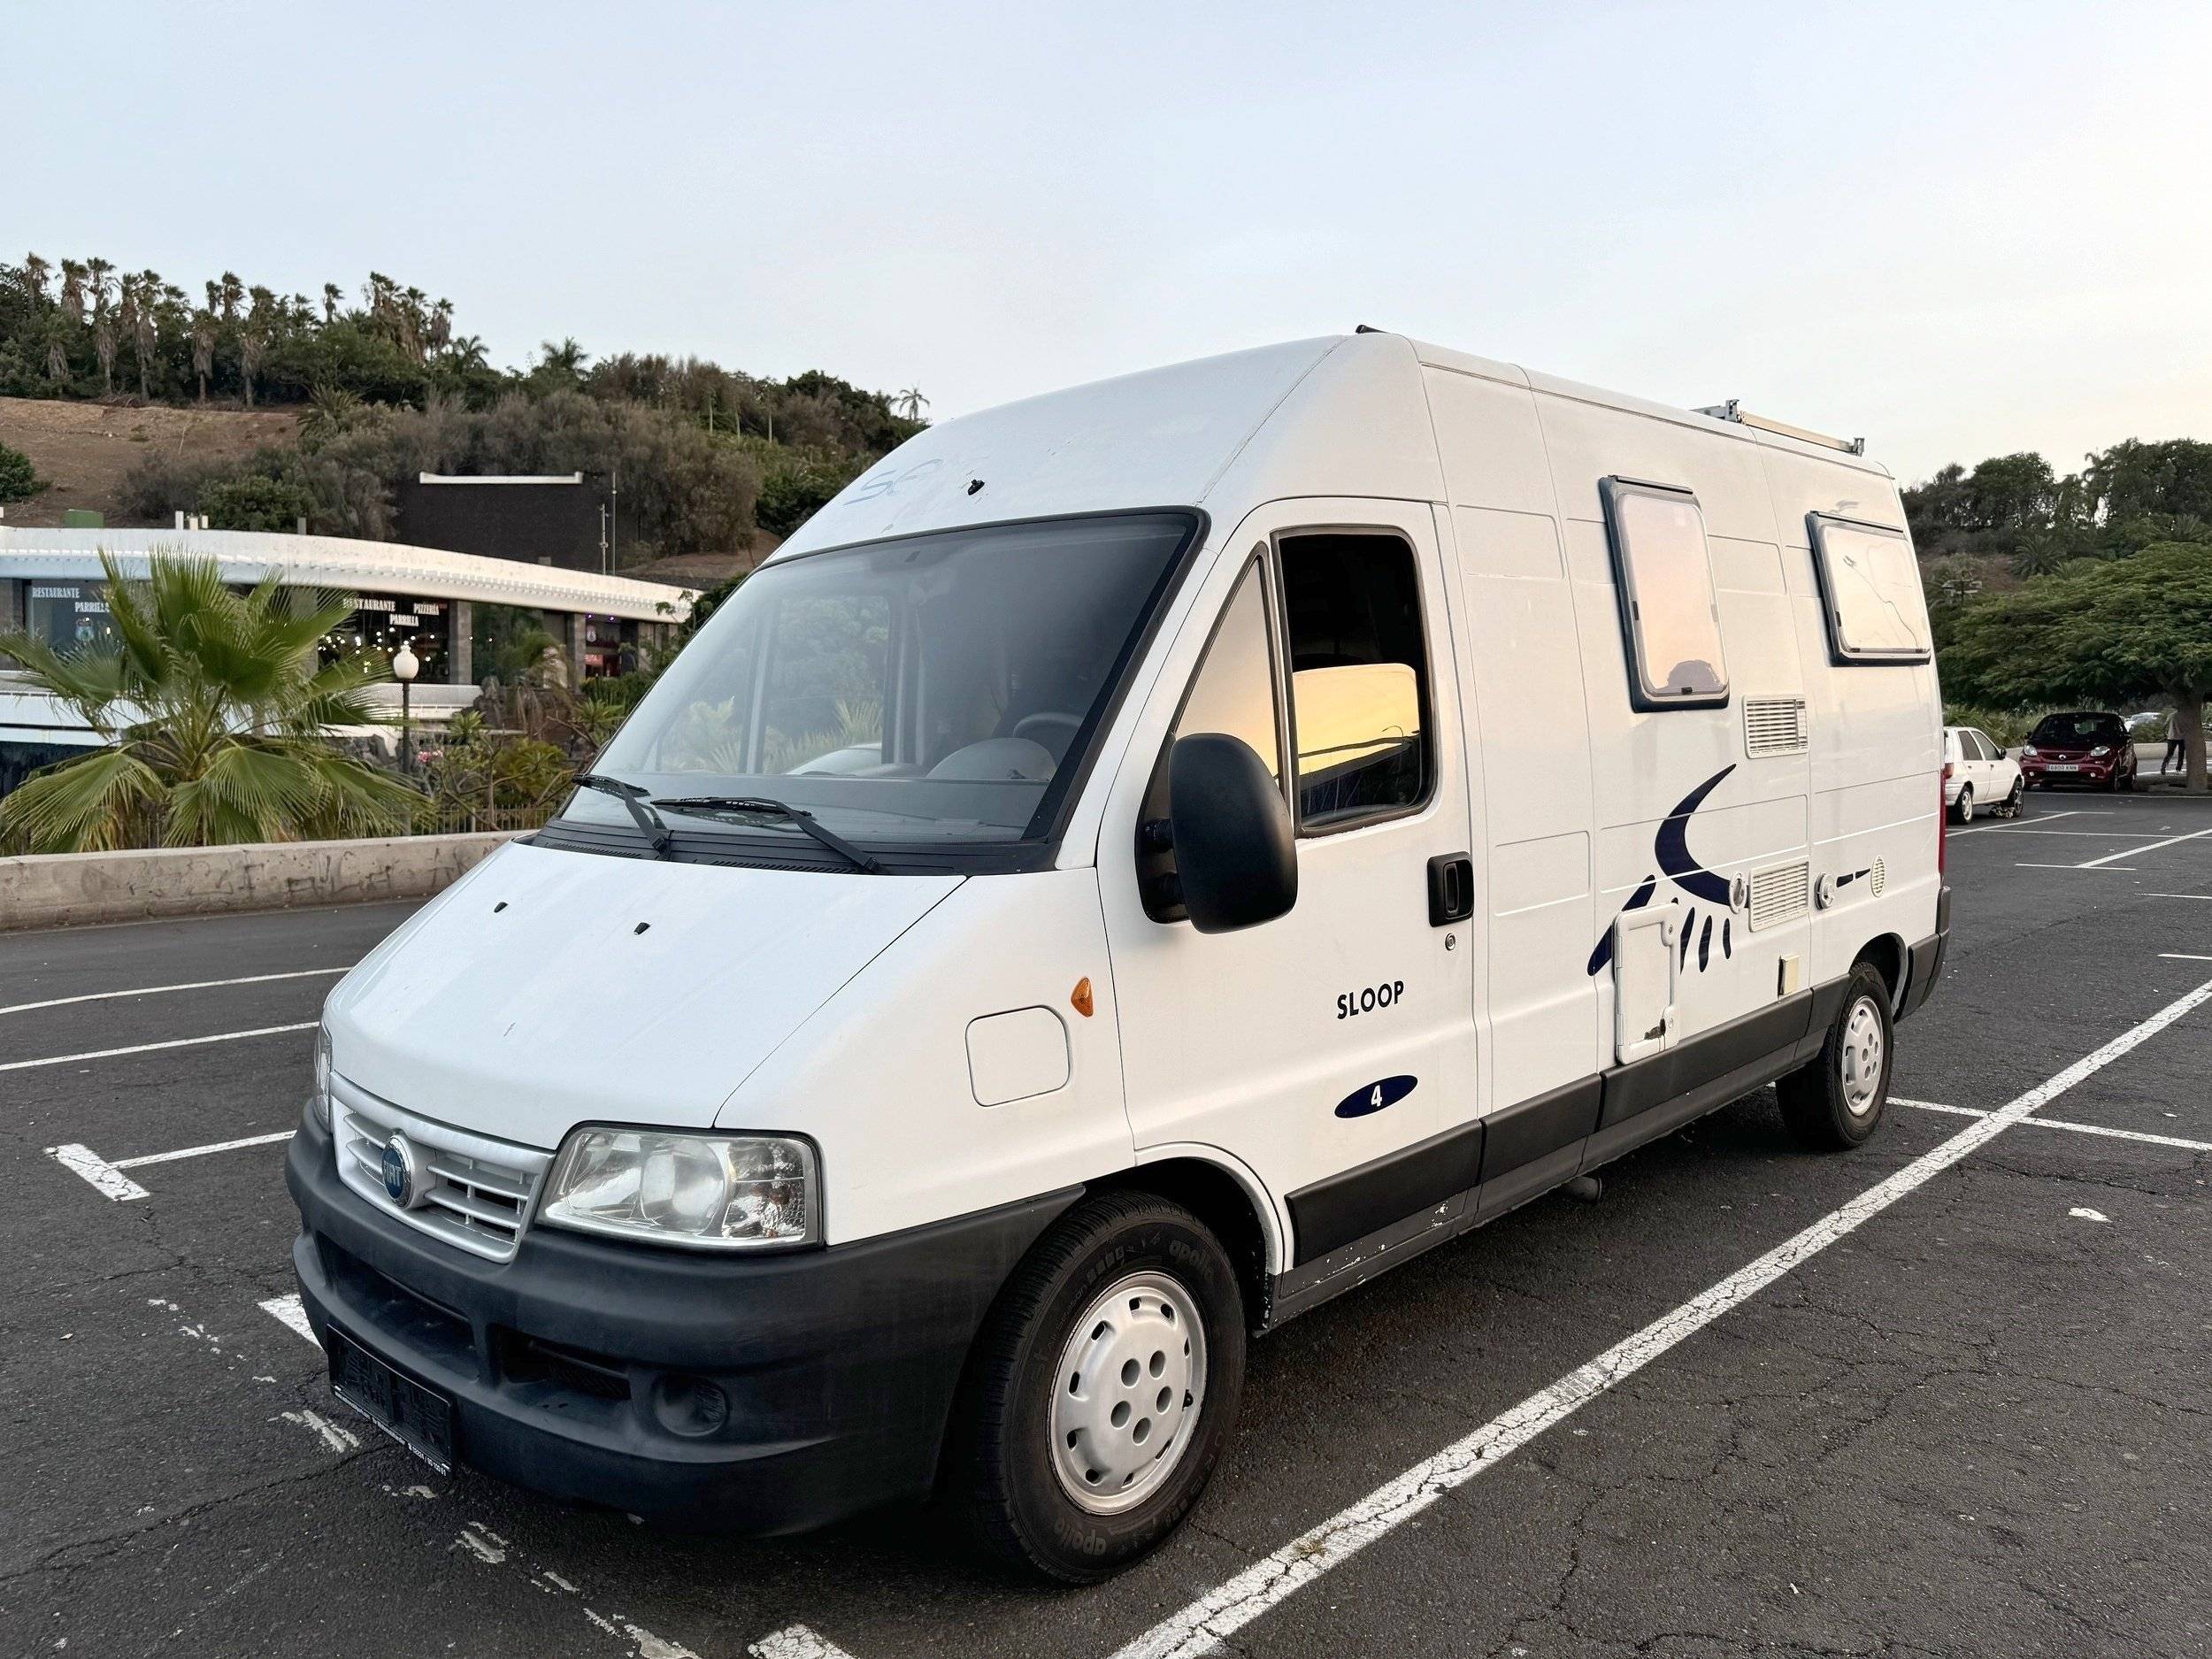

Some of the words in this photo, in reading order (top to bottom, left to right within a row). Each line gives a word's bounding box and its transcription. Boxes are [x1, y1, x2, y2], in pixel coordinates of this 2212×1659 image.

[32, 588, 81, 598] RESTAURANTE
[389, 613, 419, 626] PARRILLA
[1337, 980, 1404, 1019] SLOOP
[1371, 1085, 1383, 1107] 4
[383, 1160, 403, 1187] FIAT
